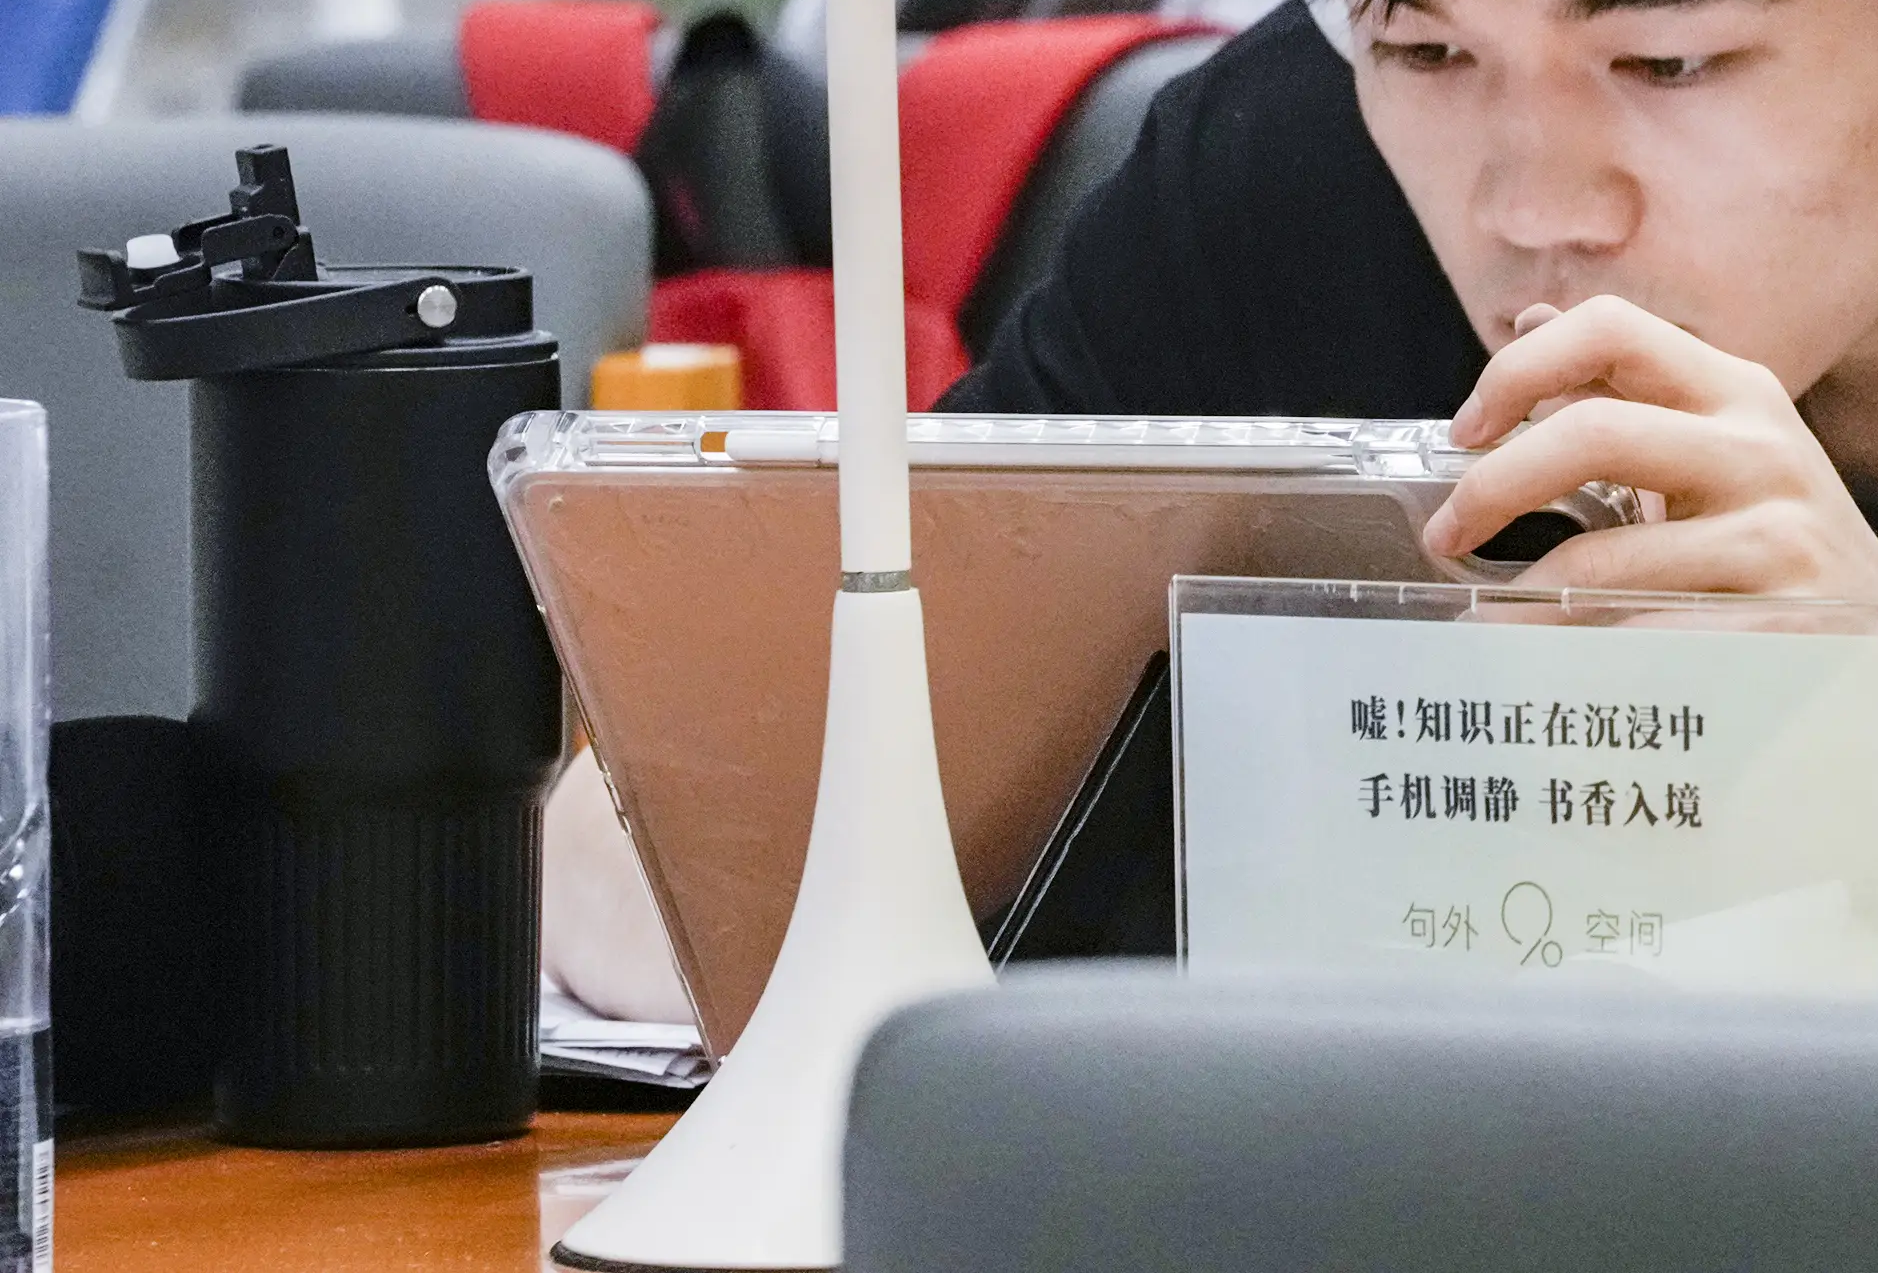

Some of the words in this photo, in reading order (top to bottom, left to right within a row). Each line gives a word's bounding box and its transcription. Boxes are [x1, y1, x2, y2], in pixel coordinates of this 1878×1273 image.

[1351, 695, 1704, 752] 嘘!知识正在沉浸中
[1358, 772, 1519, 822] 手机调静
[1538, 777, 1703, 829] 书香入境
[1402, 901, 1479, 952] 句外
[1585, 908, 1664, 957] 空间
